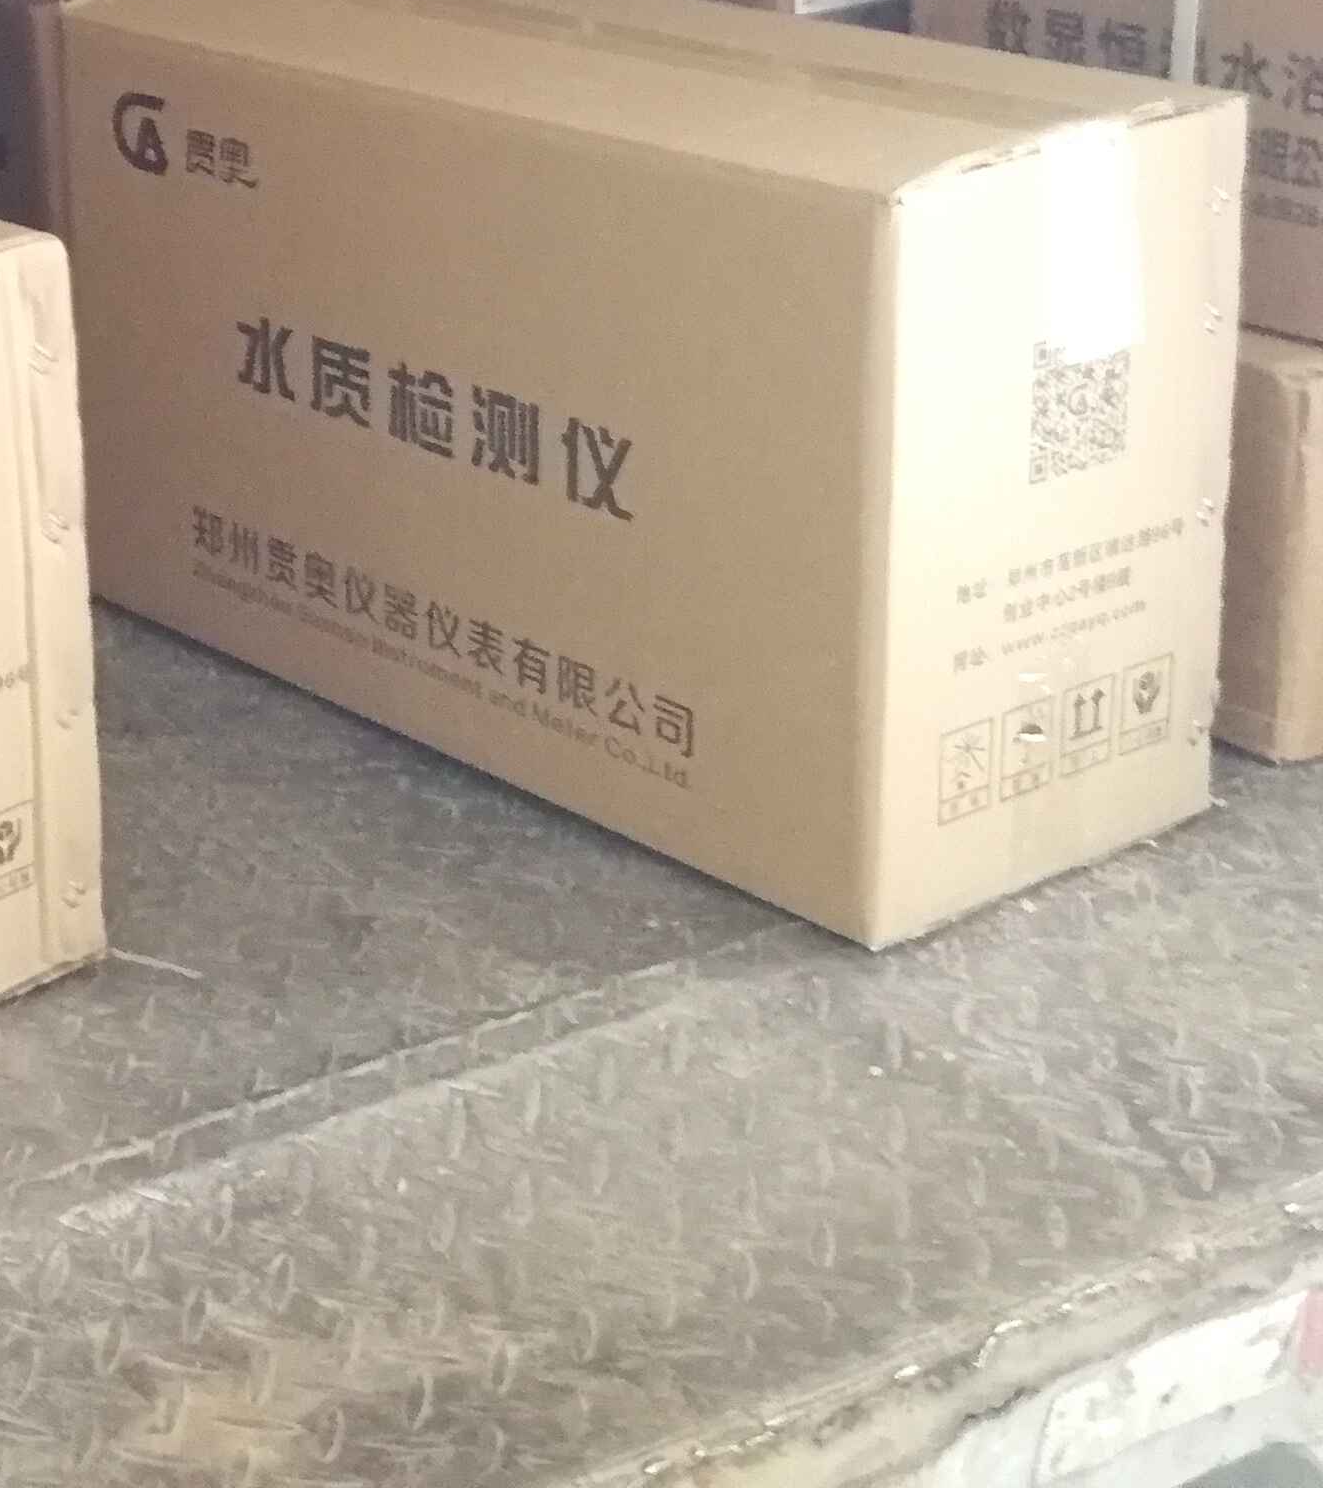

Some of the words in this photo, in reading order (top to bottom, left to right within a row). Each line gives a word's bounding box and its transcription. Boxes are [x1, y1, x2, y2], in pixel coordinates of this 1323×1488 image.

[235, 315, 634, 522] 水质检测仪
